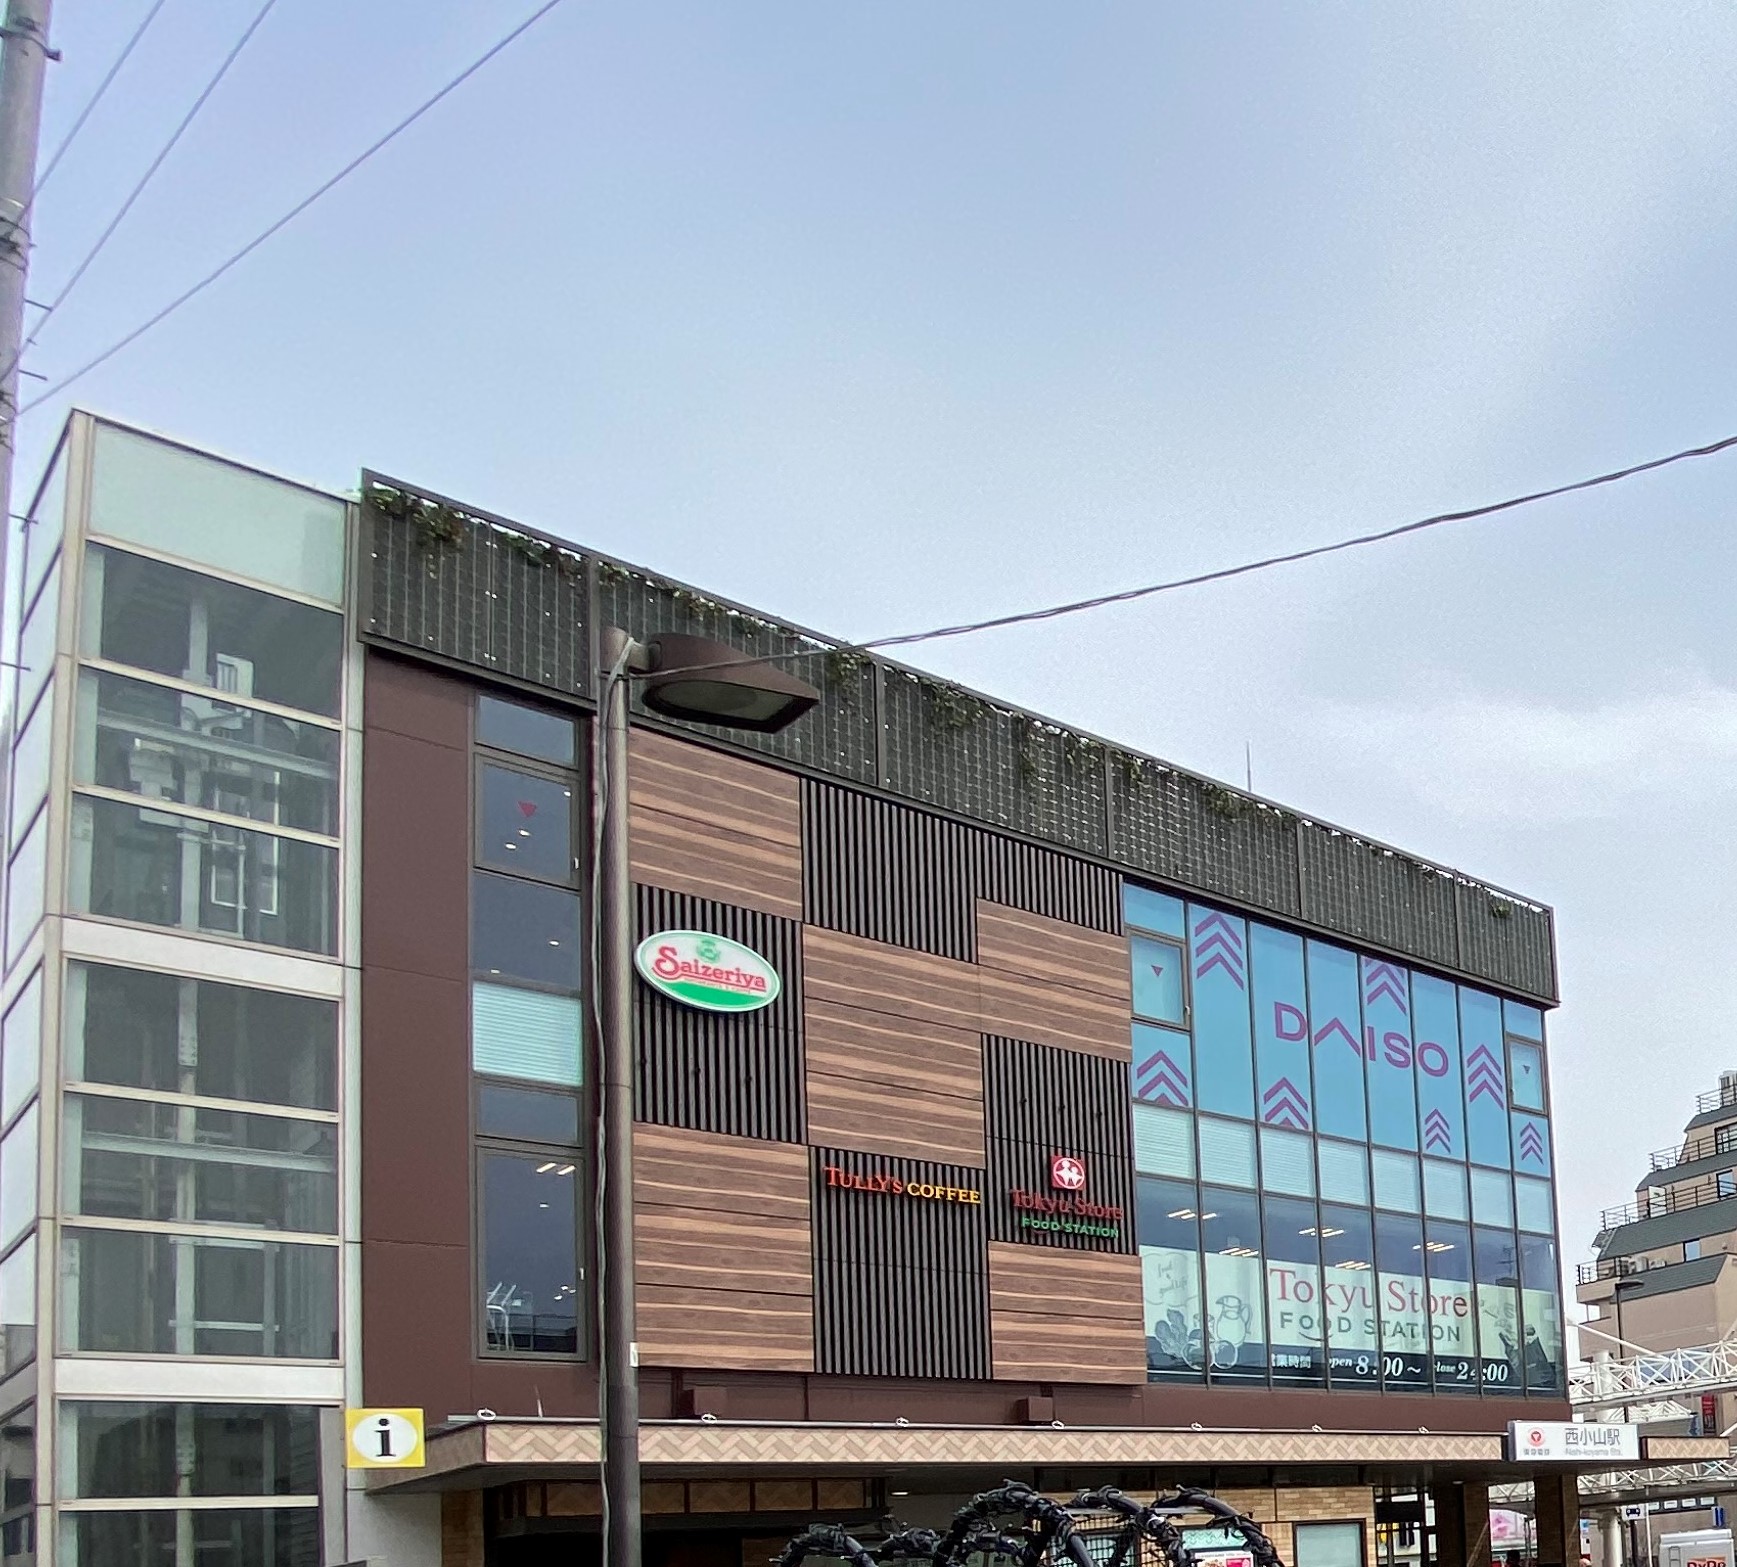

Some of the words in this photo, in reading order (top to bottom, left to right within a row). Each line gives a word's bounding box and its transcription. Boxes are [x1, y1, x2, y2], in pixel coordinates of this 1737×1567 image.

[653, 946, 766, 989] Saizeriya
[823, 1164, 903, 1195] TULLY'S
[906, 1182, 981, 1204] COFFEE
[1010, 1189, 1071, 1214] Tokyu
[1074, 1198, 1122, 1219] Store
[1022, 1217, 1061, 1231] FOOD
[1064, 1223, 1119, 1239] STATION
[1434, 1361, 1456, 1373] lose
[1565, 1427, 1621, 1446] 西小山駅
